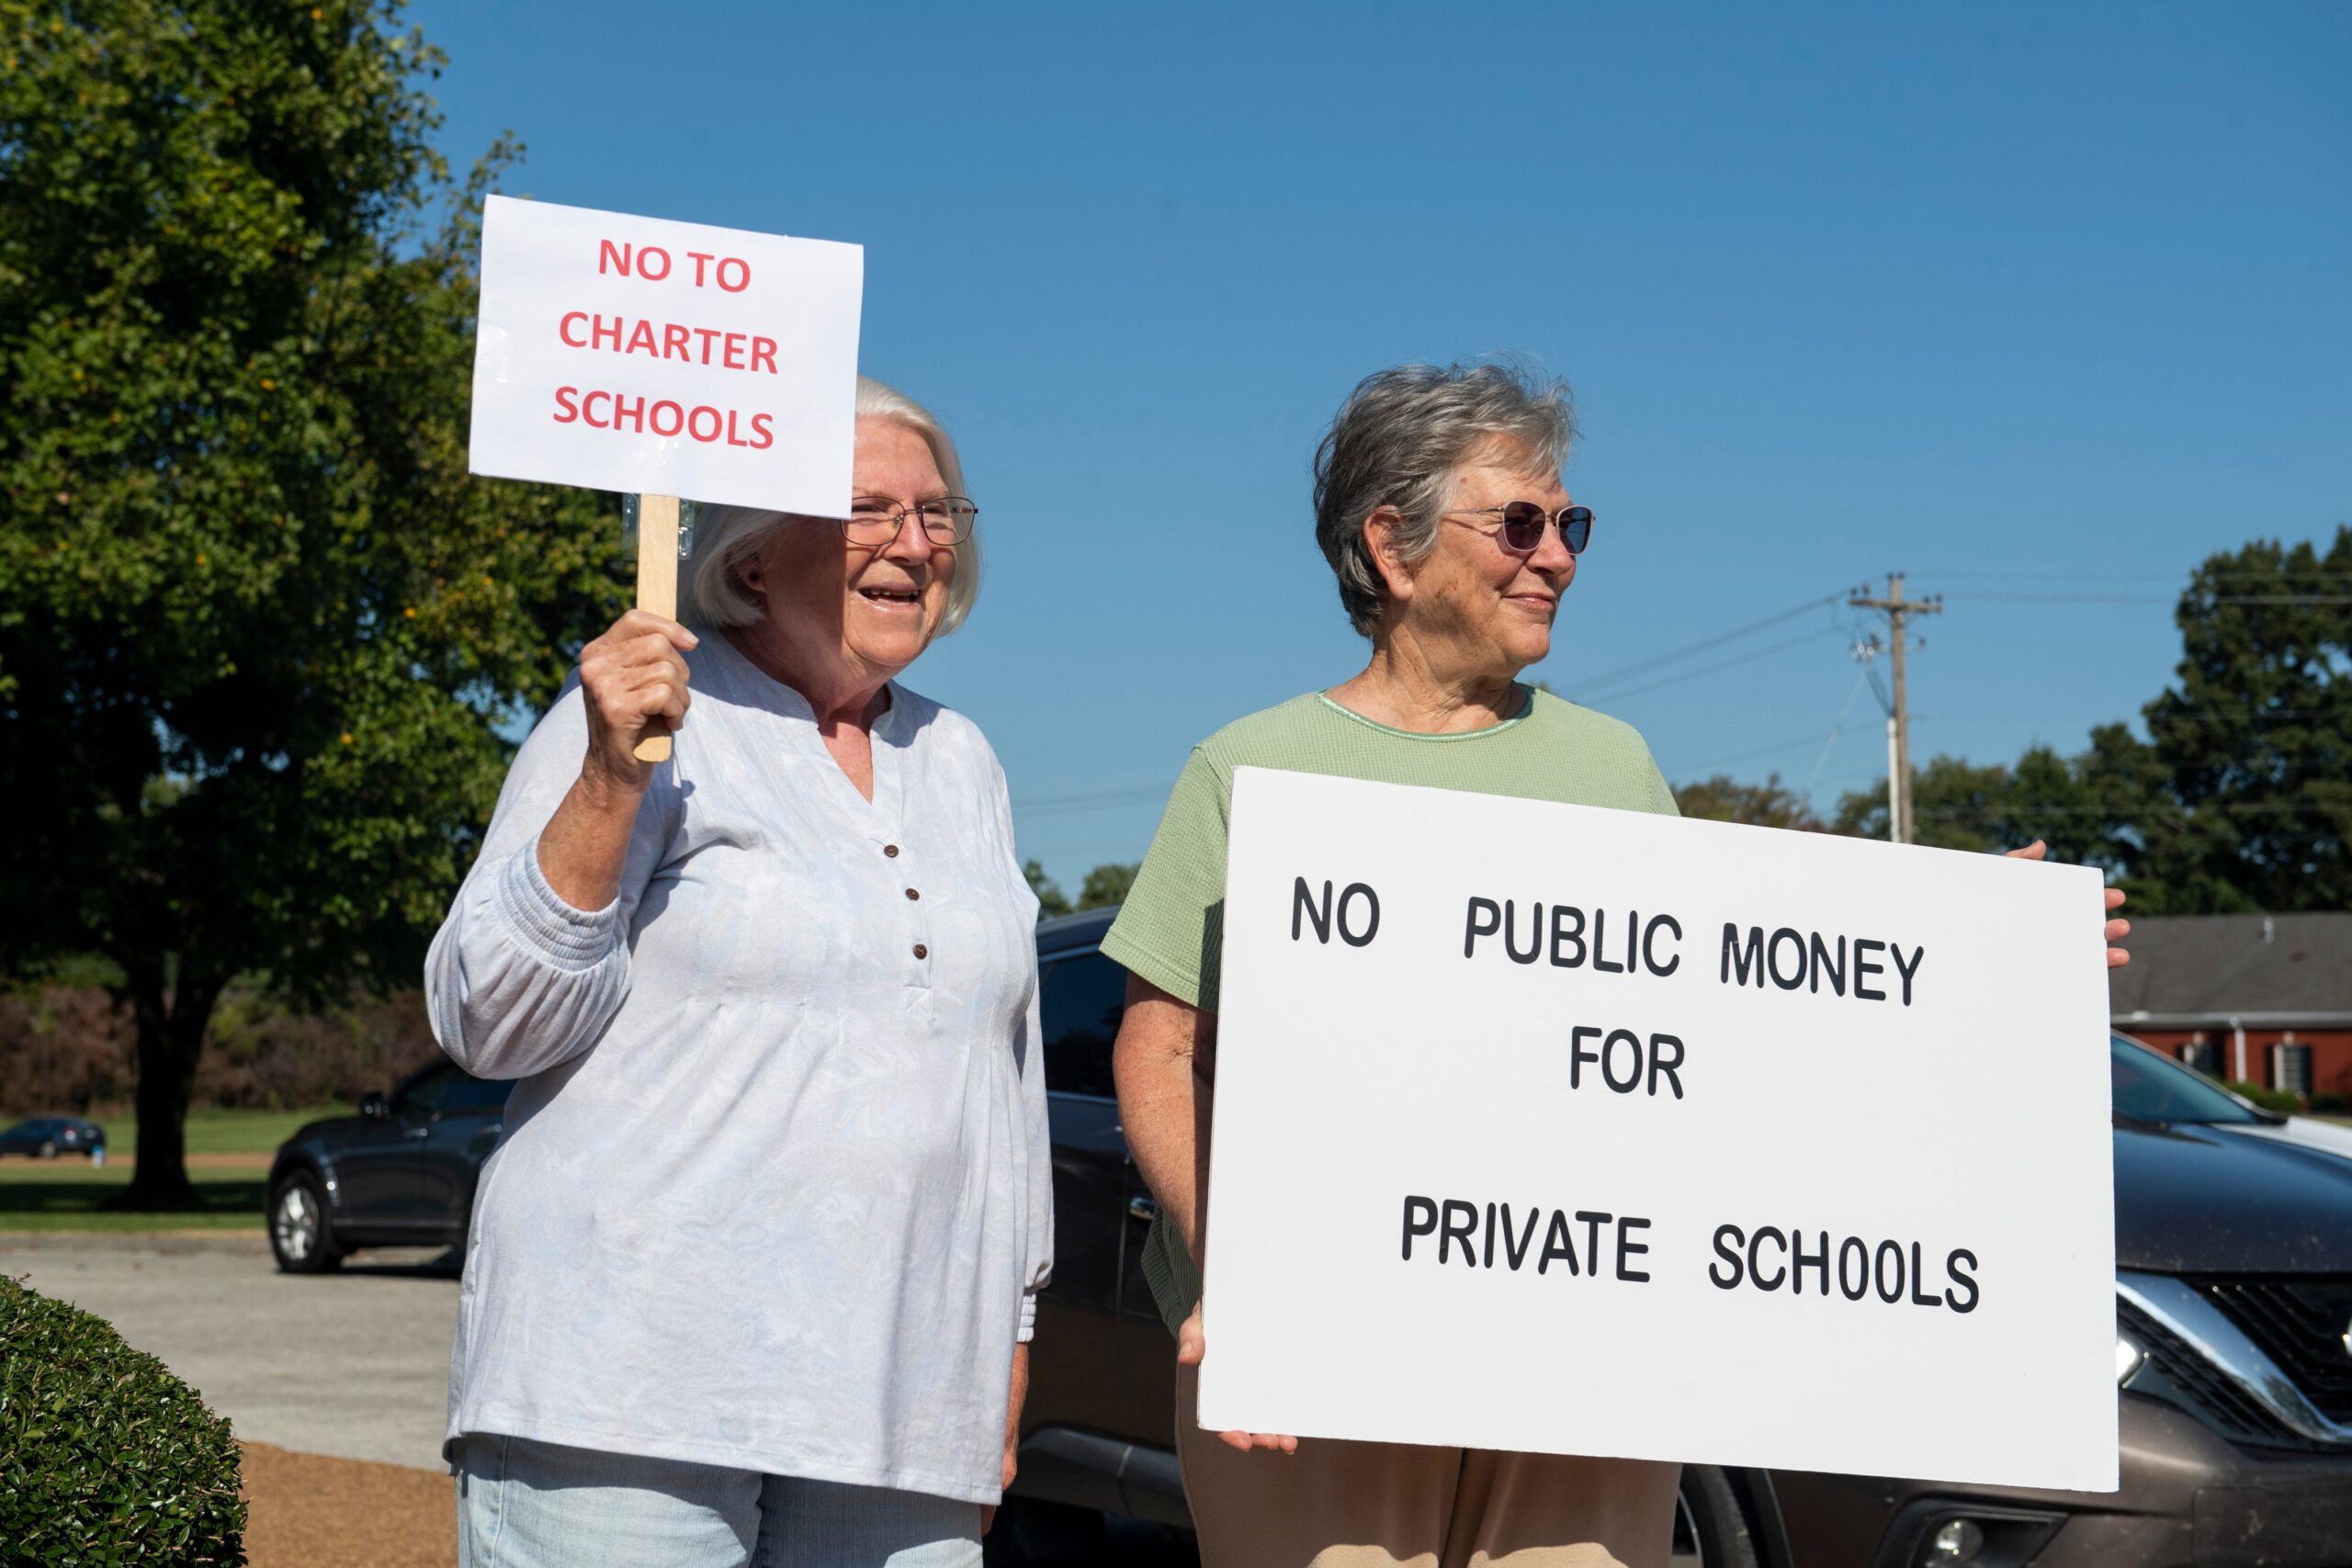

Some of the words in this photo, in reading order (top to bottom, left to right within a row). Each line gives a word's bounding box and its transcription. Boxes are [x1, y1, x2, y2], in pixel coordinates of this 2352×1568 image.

[599, 239, 672, 281] NO
[687, 252, 750, 292] TO
[560, 311, 778, 375] CHARTER
[553, 386, 774, 450] SCHOOLS
[1292, 876, 1379, 947] NO
[1464, 897, 1683, 978] PUBLIC
[1721, 922, 1925, 1007] MONEY
[1571, 1026, 1685, 1100] FOR
[1402, 1196, 1652, 1283] PRIVATE
